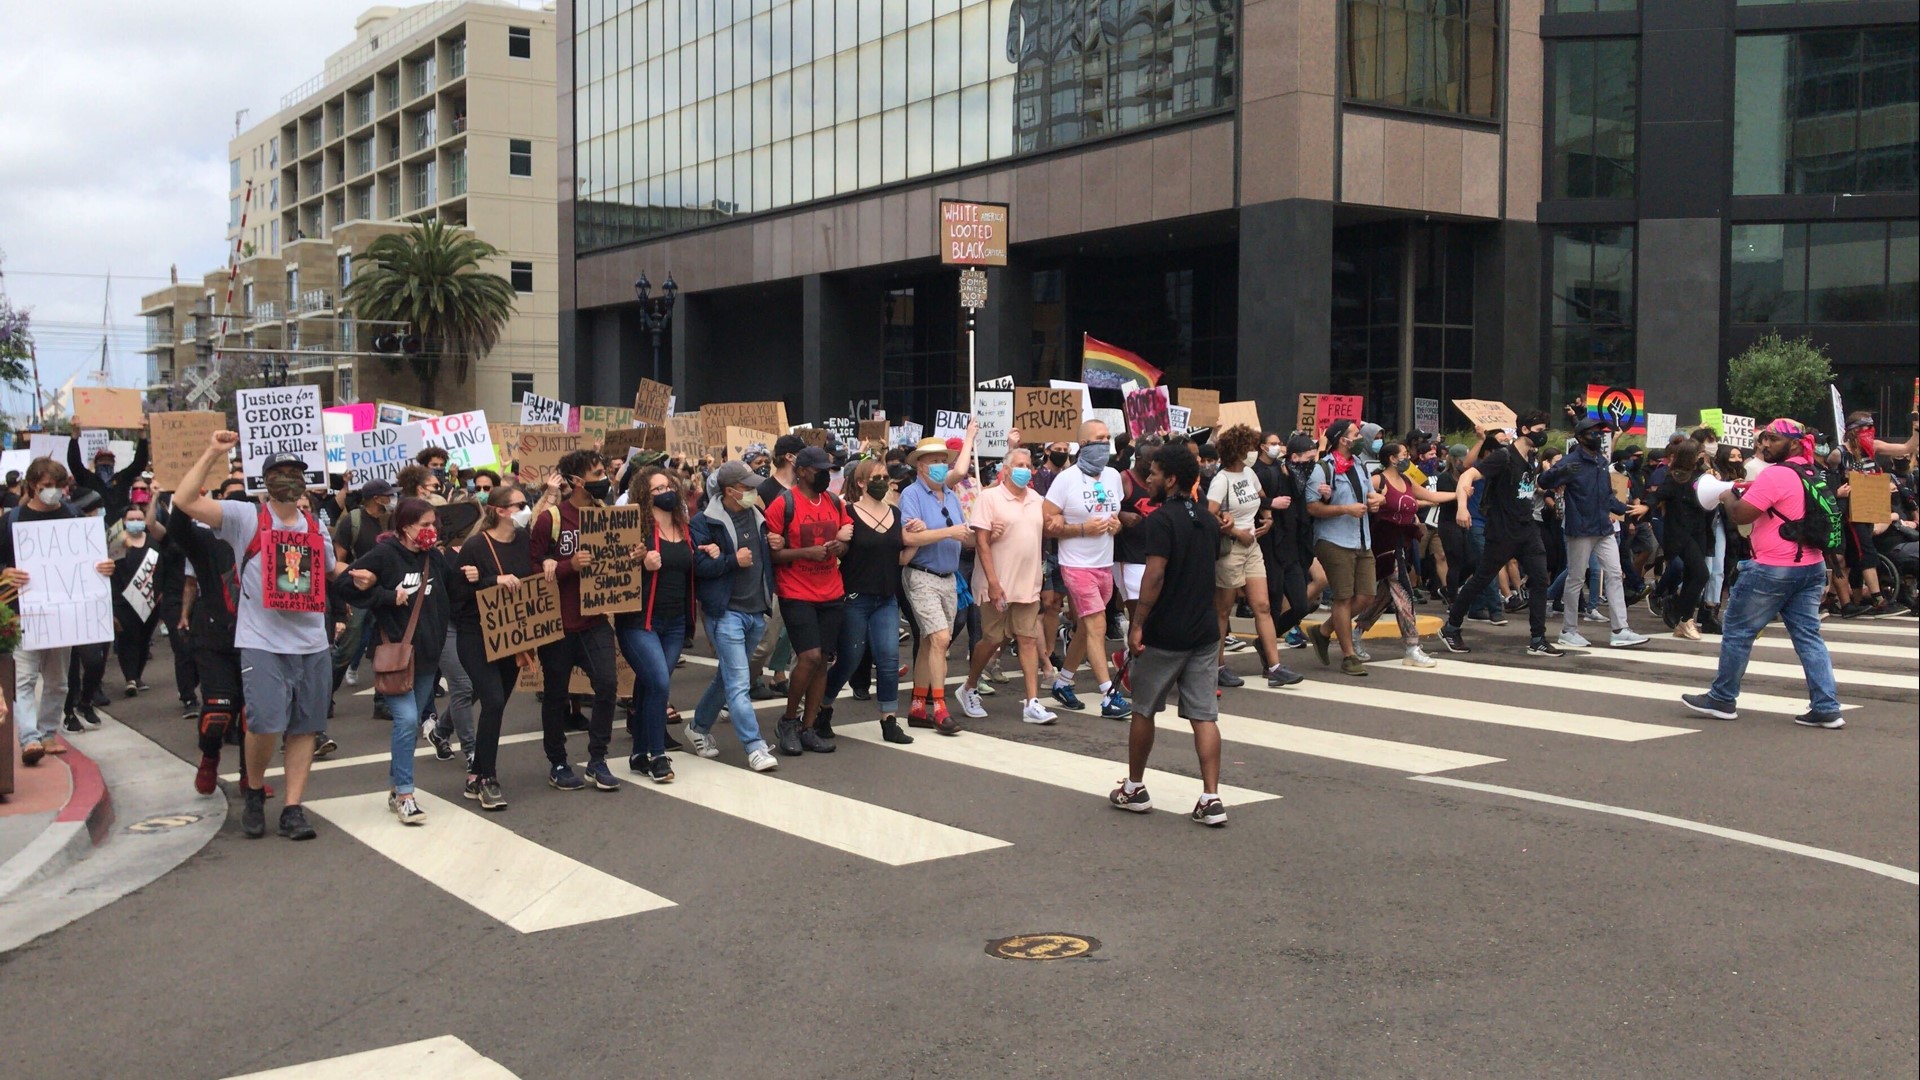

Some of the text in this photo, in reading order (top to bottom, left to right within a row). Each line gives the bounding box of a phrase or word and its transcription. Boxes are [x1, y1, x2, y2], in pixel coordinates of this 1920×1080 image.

[944, 204, 978, 222] WHITE
[951, 224, 992, 239] LOOTED
[952, 242, 985, 259] BLACK
[962, 270, 984, 278] FUND
[962, 292, 981, 300] NOT
[641, 378, 670, 397] BLACK
[242, 388, 314, 410] Justice for
[524, 394, 564, 417] Matter
[1026, 390, 1073, 408] FUCK
[1416, 400, 1438, 408] REFORM
[246, 406, 314, 423] GEORGE
[528, 410, 560, 424] Lives
[636, 401, 667, 423] MATTER
[704, 406, 735, 416] WHO
[738, 406, 755, 415] DO
[757, 404, 777, 414] YOU
[1328, 404, 1352, 416] FREE
[421, 412, 474, 437] TOP
[704, 416, 776, 428] CALL WHEN THE
[1016, 408, 1078, 430] TRUMP
[362, 428, 398, 448] END
[426, 426, 486, 450] ILLING
[985, 430, 1004, 438] LIVES
[1724, 426, 1754, 437] IVES
[248, 438, 318, 460] Jail Killer
[520, 434, 539, 456] NO
[539, 434, 582, 452] JUSTICE
[352, 444, 407, 466] POLICE
[350, 458, 418, 485] BRUTALIT
[520, 464, 540, 484] NO
[271, 530, 310, 546] BLACK
[604, 532, 620, 544] the
[266, 545, 274, 591] LIVES
[312, 550, 320, 596] MATTER
[580, 561, 607, 578] JAZZ
[594, 574, 632, 590] SHOULD
[268, 592, 315, 602] NOW DO YOU
[482, 577, 549, 610] WHITE
[606, 590, 622, 604] die
[270, 600, 324, 612] UNDERSTAND?
[486, 594, 556, 630] SILENCE
[518, 620, 528, 628] IS
[489, 618, 562, 654] VIOLENCE
